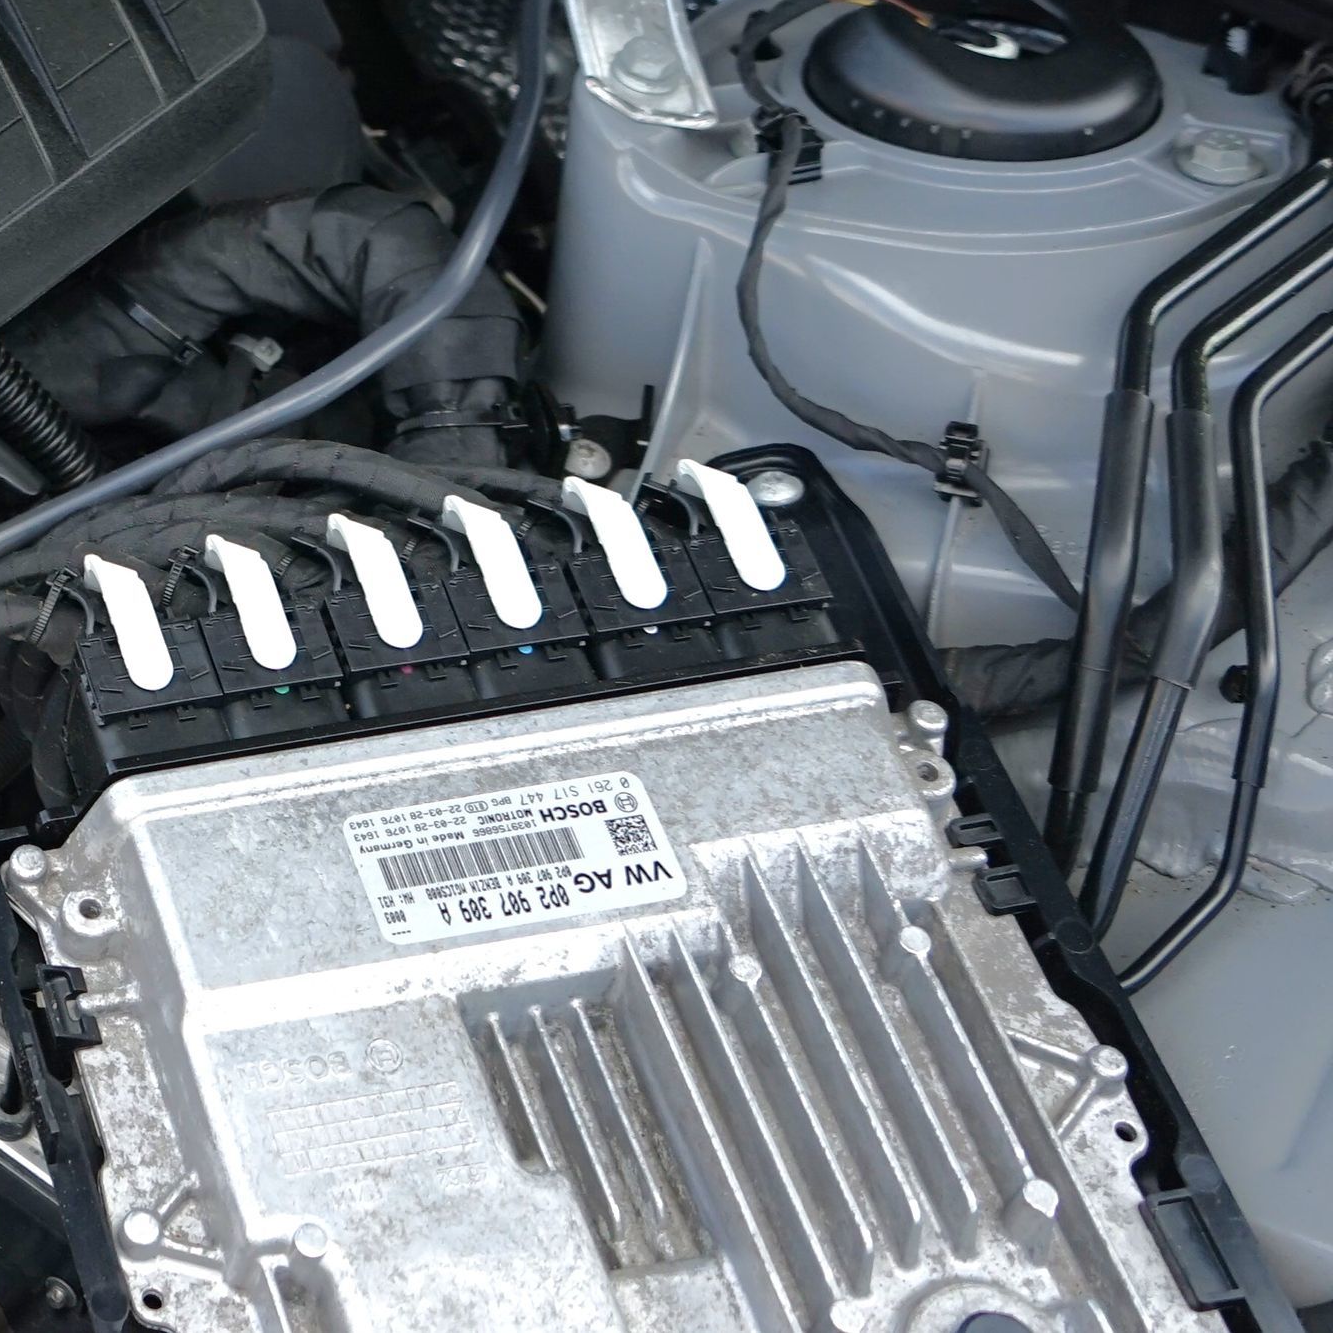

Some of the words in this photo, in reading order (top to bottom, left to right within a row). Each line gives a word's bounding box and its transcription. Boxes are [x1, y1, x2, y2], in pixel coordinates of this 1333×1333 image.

[585, 779, 613, 793] 261
[617, 776, 630, 788] 0
[517, 790, 545, 804] 447
[551, 785, 579, 798] S17
[490, 796, 511, 806] BPG
[408, 804, 462, 820] 22-03-28
[475, 807, 533, 825] MOTRONIC
[538, 798, 608, 823] BOSCH
[347, 818, 375, 830] 1643
[379, 813, 407, 825] 1076
[413, 815, 467, 832] 22-03-28
[352, 830, 380, 842] 1643
[383, 824, 411, 837] 1076
[437, 829, 465, 842] Made
[357, 836, 413, 856] Germany
[415, 836, 428, 846] in
[514, 871, 534, 884] 309
[534, 868, 552, 880] 907
[552, 864, 572, 877] 0P2
[619, 858, 671, 885] VW
[467, 876, 502, 892] BENZIN
[504, 874, 514, 886] A
[569, 867, 618, 894] AG
[376, 895, 395, 908] H31
[396, 891, 415, 904] HW:
[494, 888, 532, 916] 907
[533, 882, 571, 909] 0P2
[436, 901, 453, 925] A
[455, 895, 494, 923] 309
[382, 908, 407, 925] 0003
[235, 1050, 352, 1091] BOSCH
